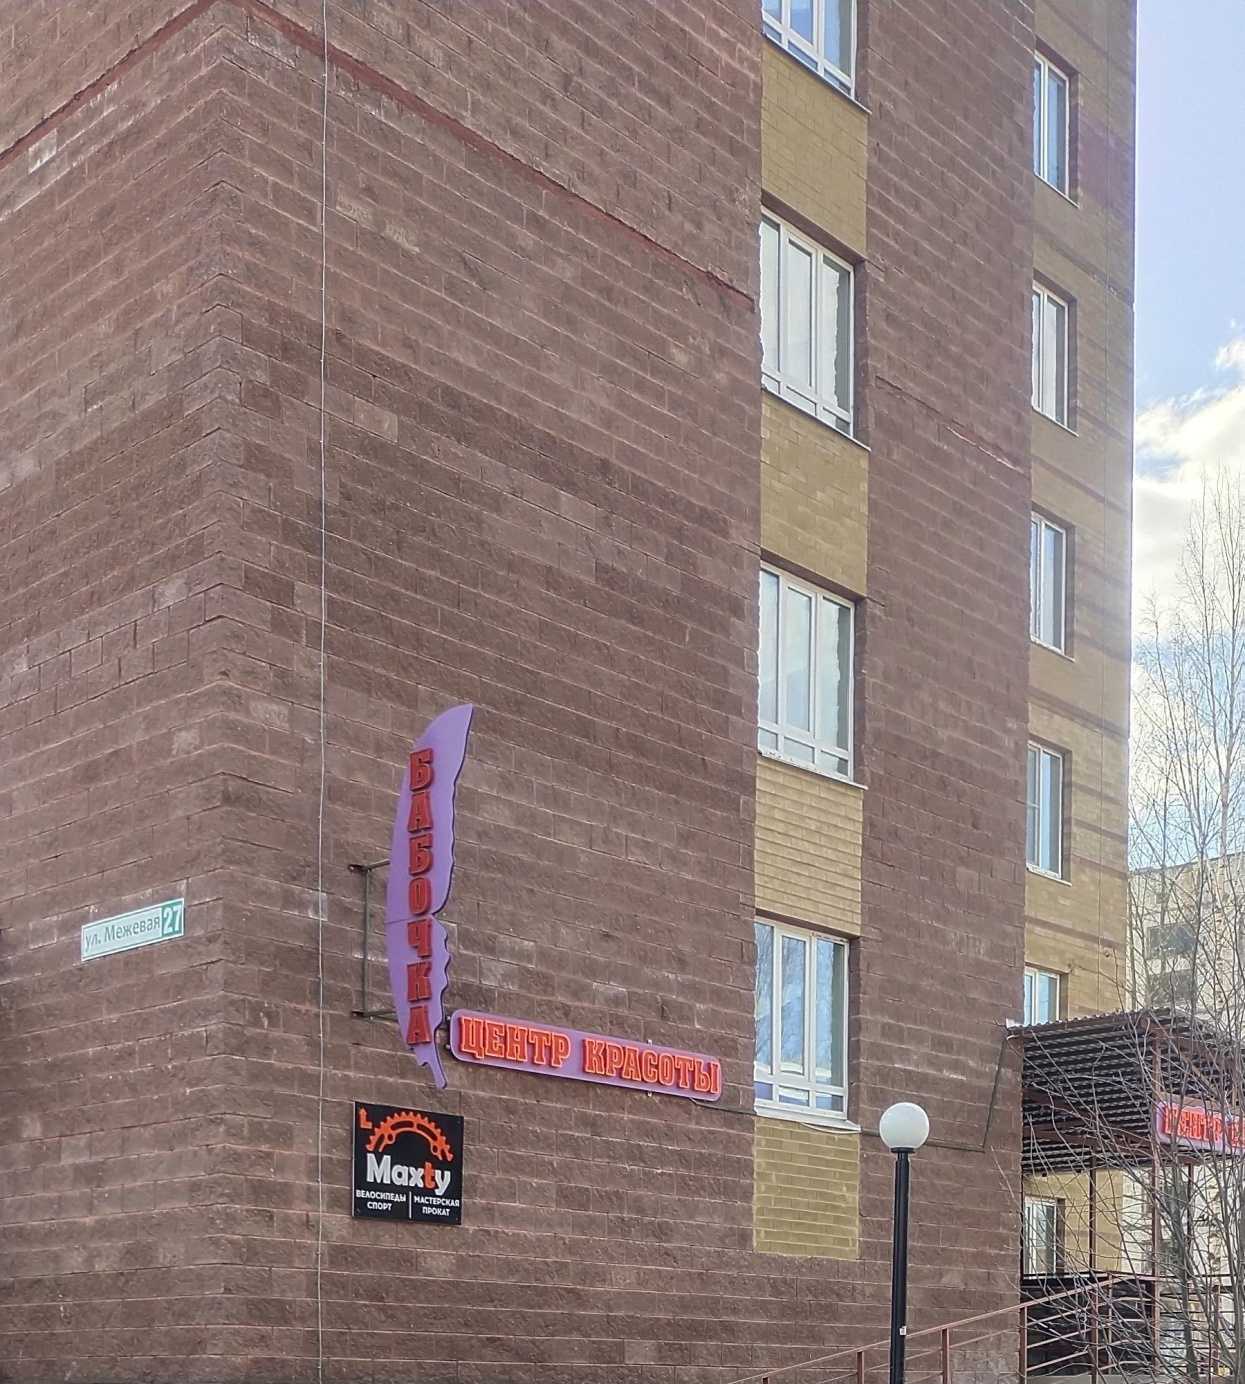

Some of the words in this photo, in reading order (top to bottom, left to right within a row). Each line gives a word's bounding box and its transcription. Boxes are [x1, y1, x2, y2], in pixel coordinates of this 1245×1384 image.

[407, 747, 434, 1045] БАБОЧКА
[85, 933, 101, 952] ул.
[104, 916, 160, 942] Межевая
[163, 904, 182, 934] 27
[459, 1016, 571, 1068] ЦЕНТР
[583, 1037, 721, 1095] КРАСОТЫ
[366, 1153, 451, 1196] Maxty
[355, 1189, 407, 1202] ВЕЛОСИПЕДЫ
[366, 1201, 392, 1211] СПОРТ
[413, 1195, 460, 1207] МАСТЕРСКАЯ
[422, 1206, 451, 1216] ПРОКАТ
